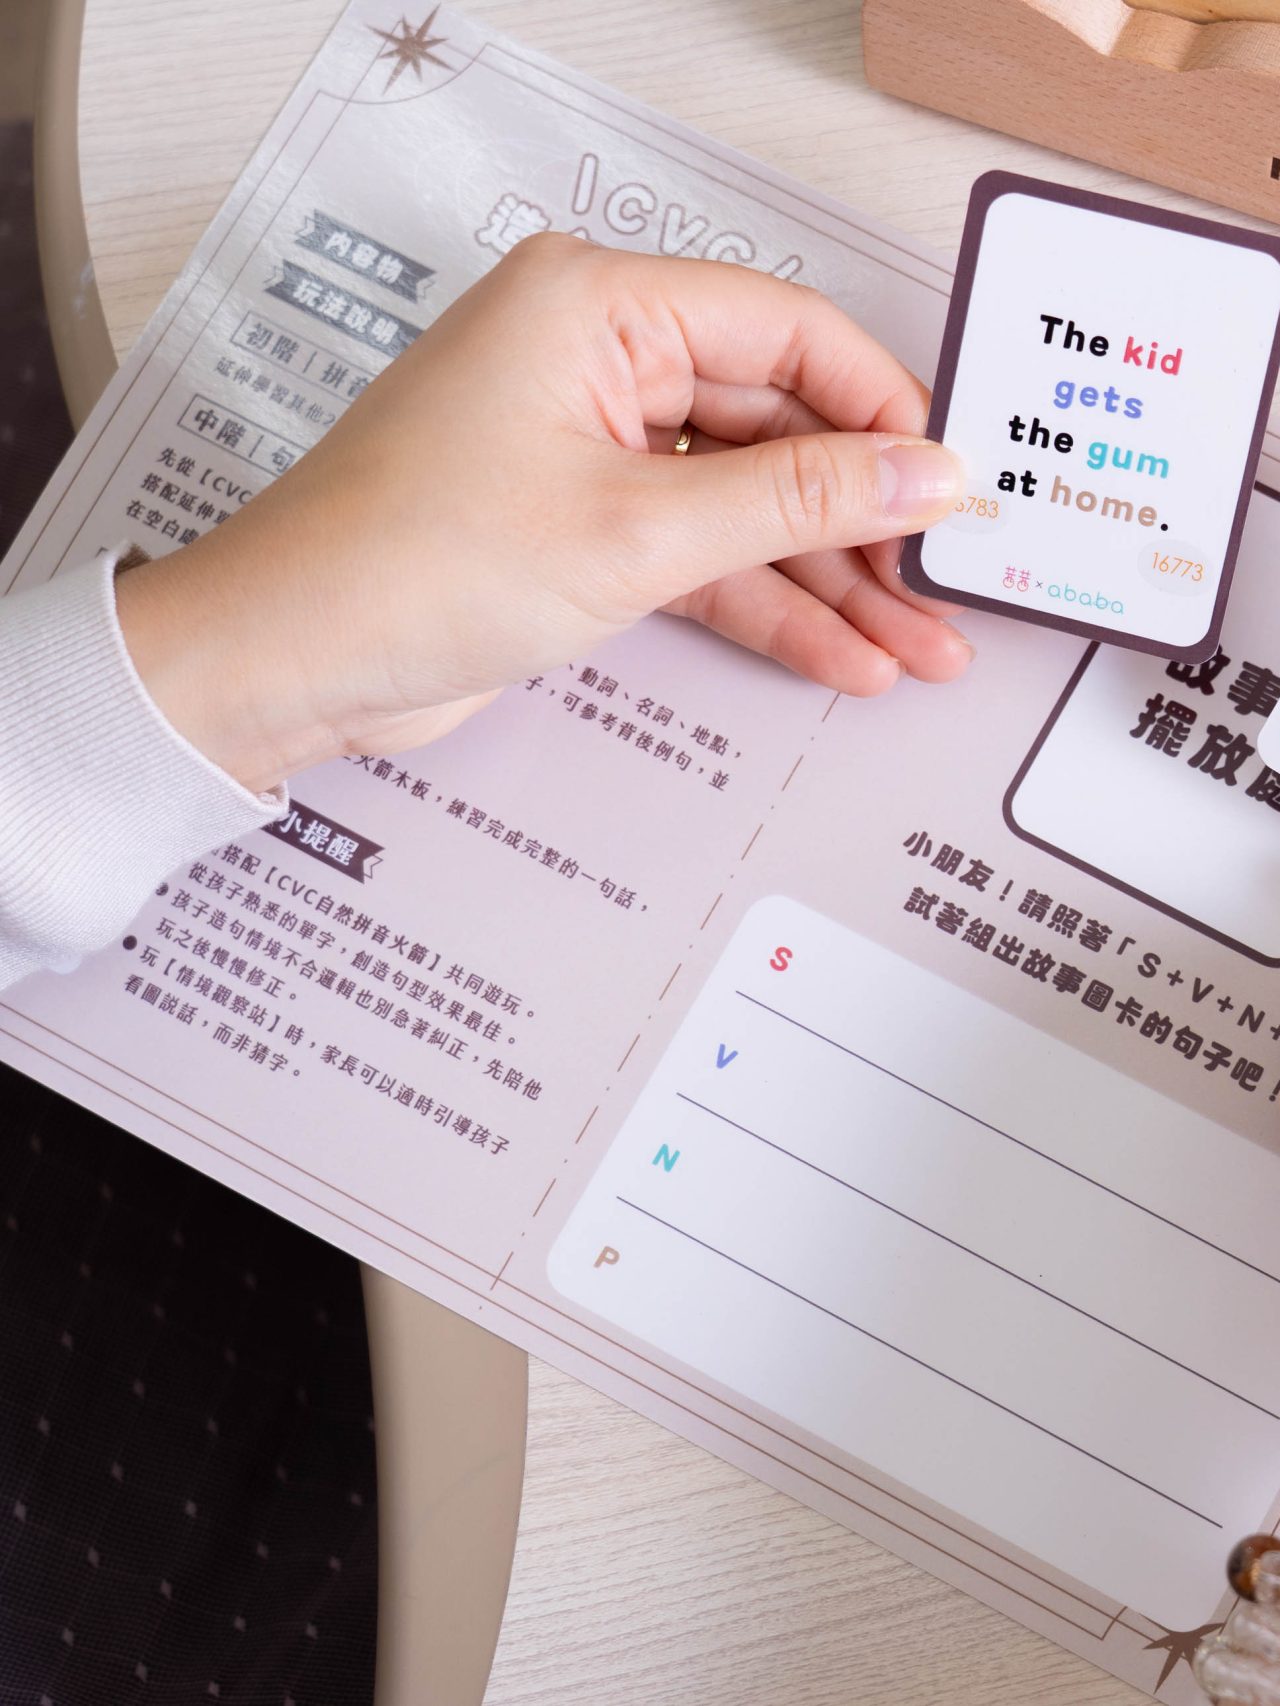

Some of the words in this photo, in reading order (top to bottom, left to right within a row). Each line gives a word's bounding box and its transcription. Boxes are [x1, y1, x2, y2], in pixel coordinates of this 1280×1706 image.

[1039, 313, 1110, 357] The
[1123, 336, 1183, 376] kid
[1053, 380, 1144, 419] gets
[1008, 415, 1074, 454] the
[1086, 441, 1170, 480] gum
[997, 470, 1037, 498] at
[1050, 476, 1169, 532] home.
[1151, 551, 1204, 582] 16773
[769, 946, 793, 972] S
[716, 1043, 739, 1069] V
[651, 1143, 681, 1172] N
[593, 1245, 621, 1269] P
